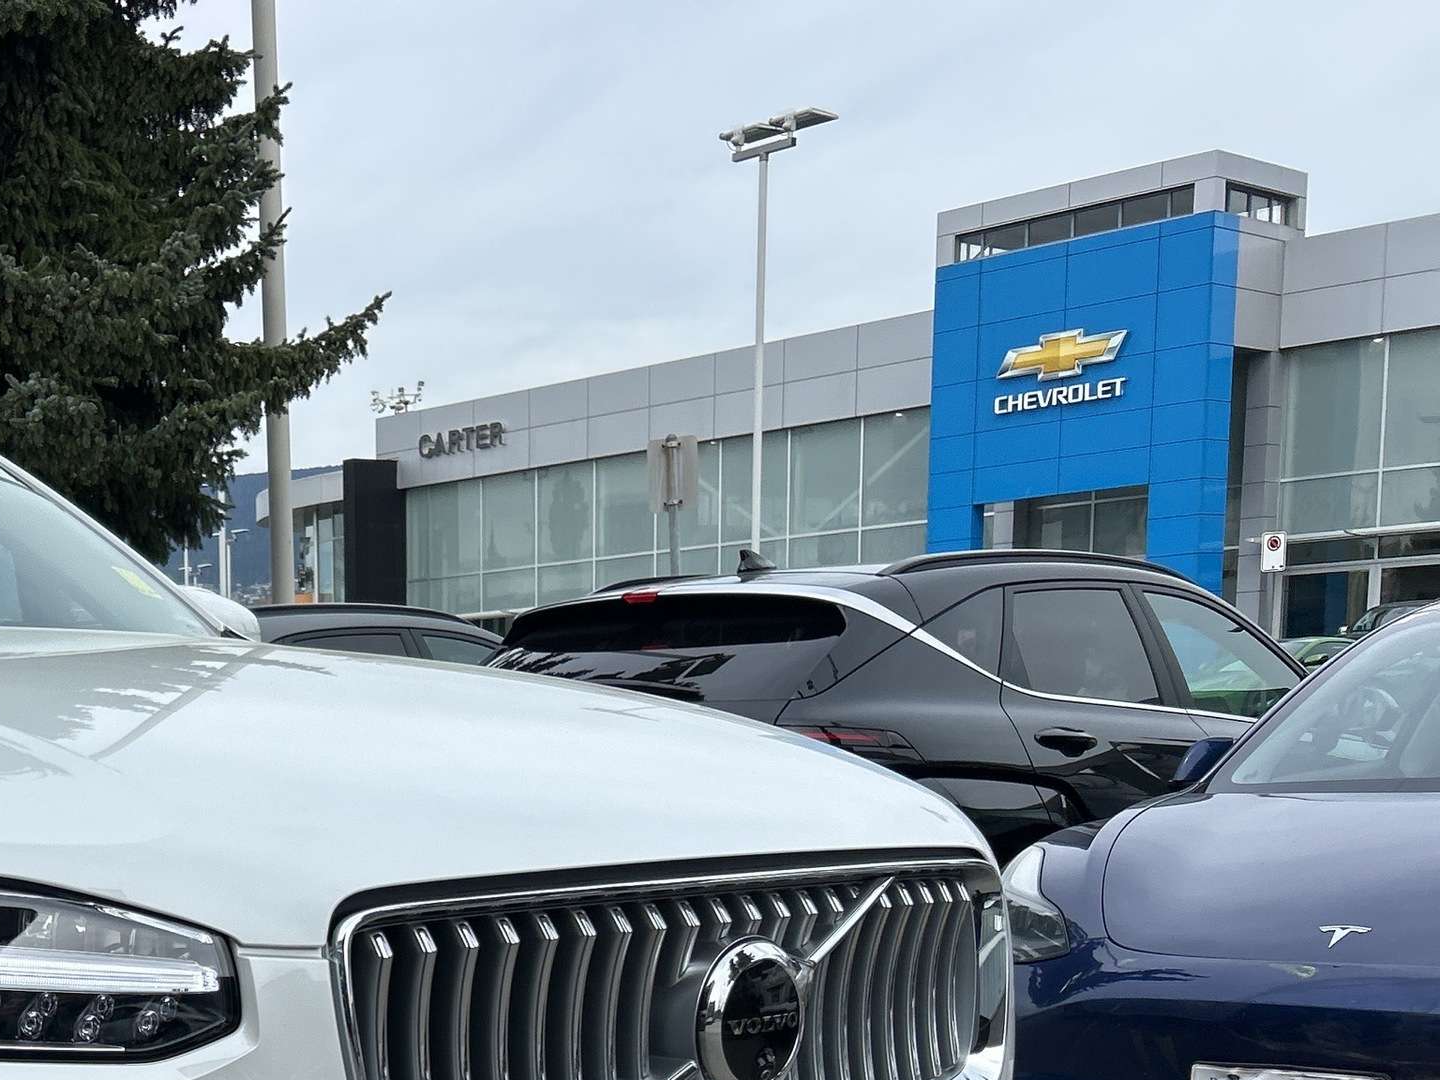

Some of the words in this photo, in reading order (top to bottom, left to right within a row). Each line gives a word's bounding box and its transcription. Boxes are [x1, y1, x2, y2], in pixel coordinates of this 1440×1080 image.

[994, 377, 1126, 415] CHEVROLET
[419, 422, 507, 459] CARTER
[727, 1011, 798, 1035] VOLVO
